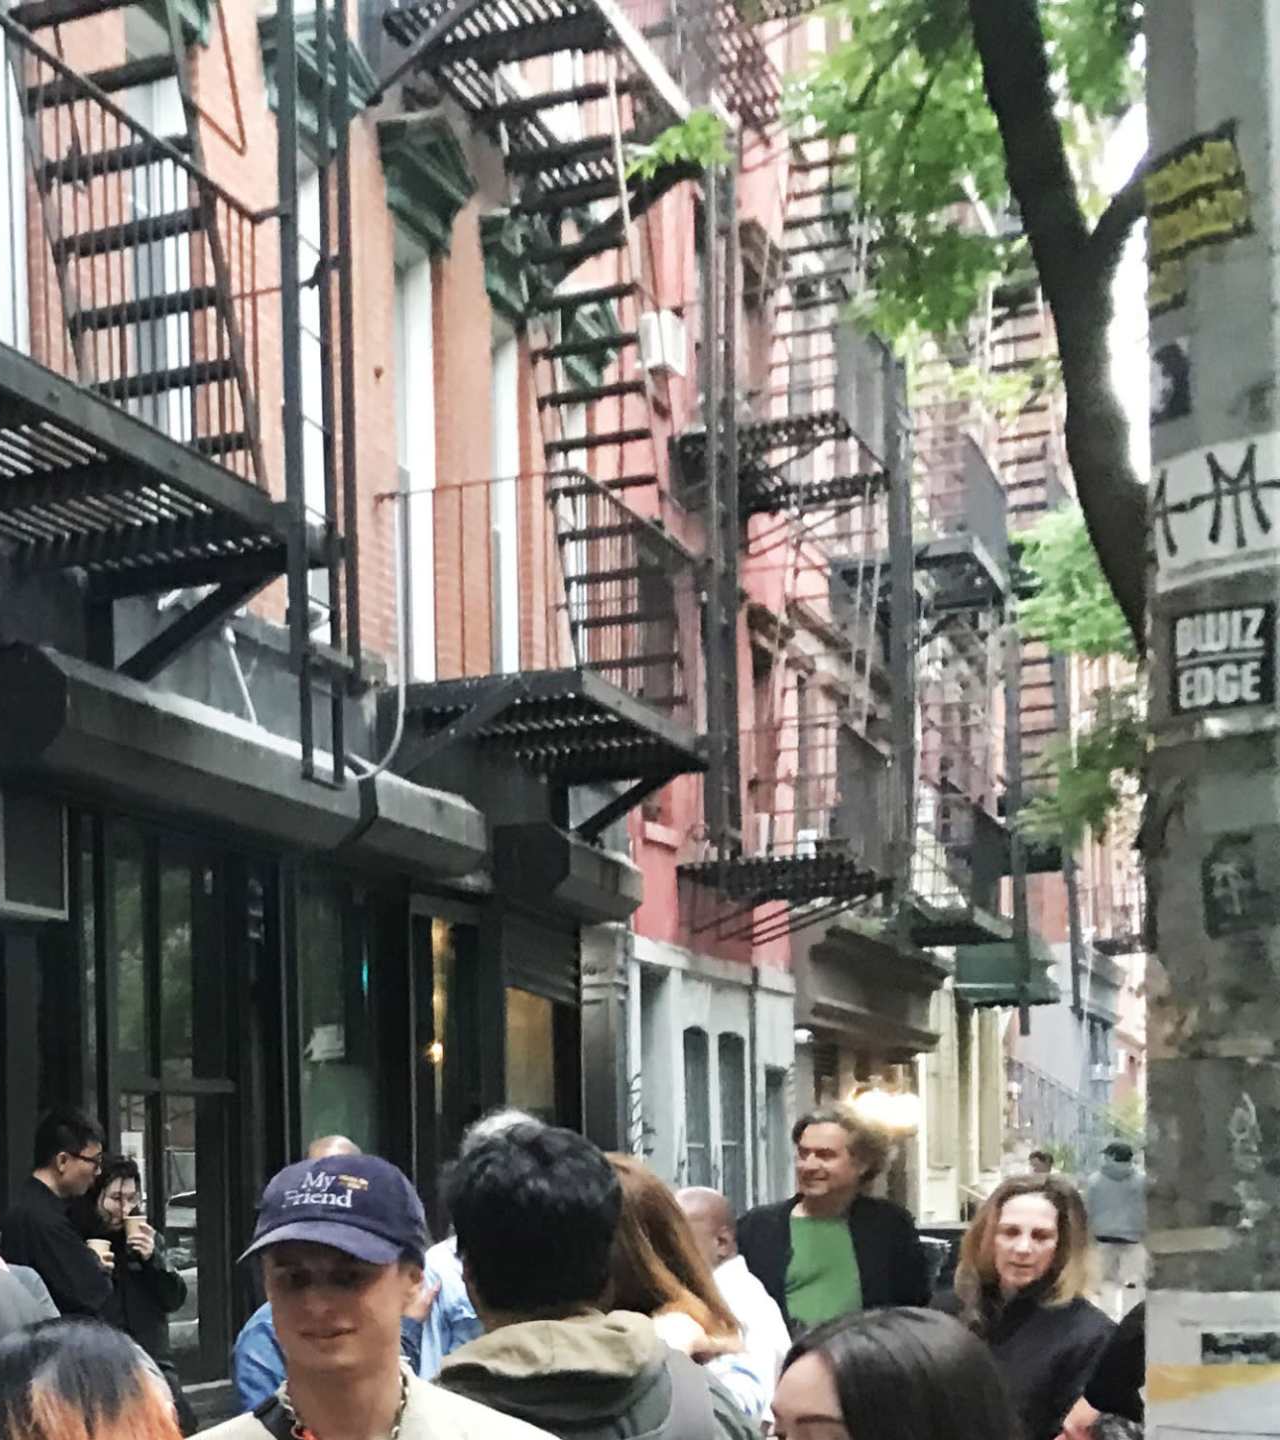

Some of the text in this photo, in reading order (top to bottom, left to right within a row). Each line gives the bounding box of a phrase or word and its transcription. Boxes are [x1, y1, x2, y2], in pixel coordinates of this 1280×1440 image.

[1178, 661, 1262, 709] EDGE
[301, 1171, 337, 1192] My
[281, 1188, 353, 1208] Friend
